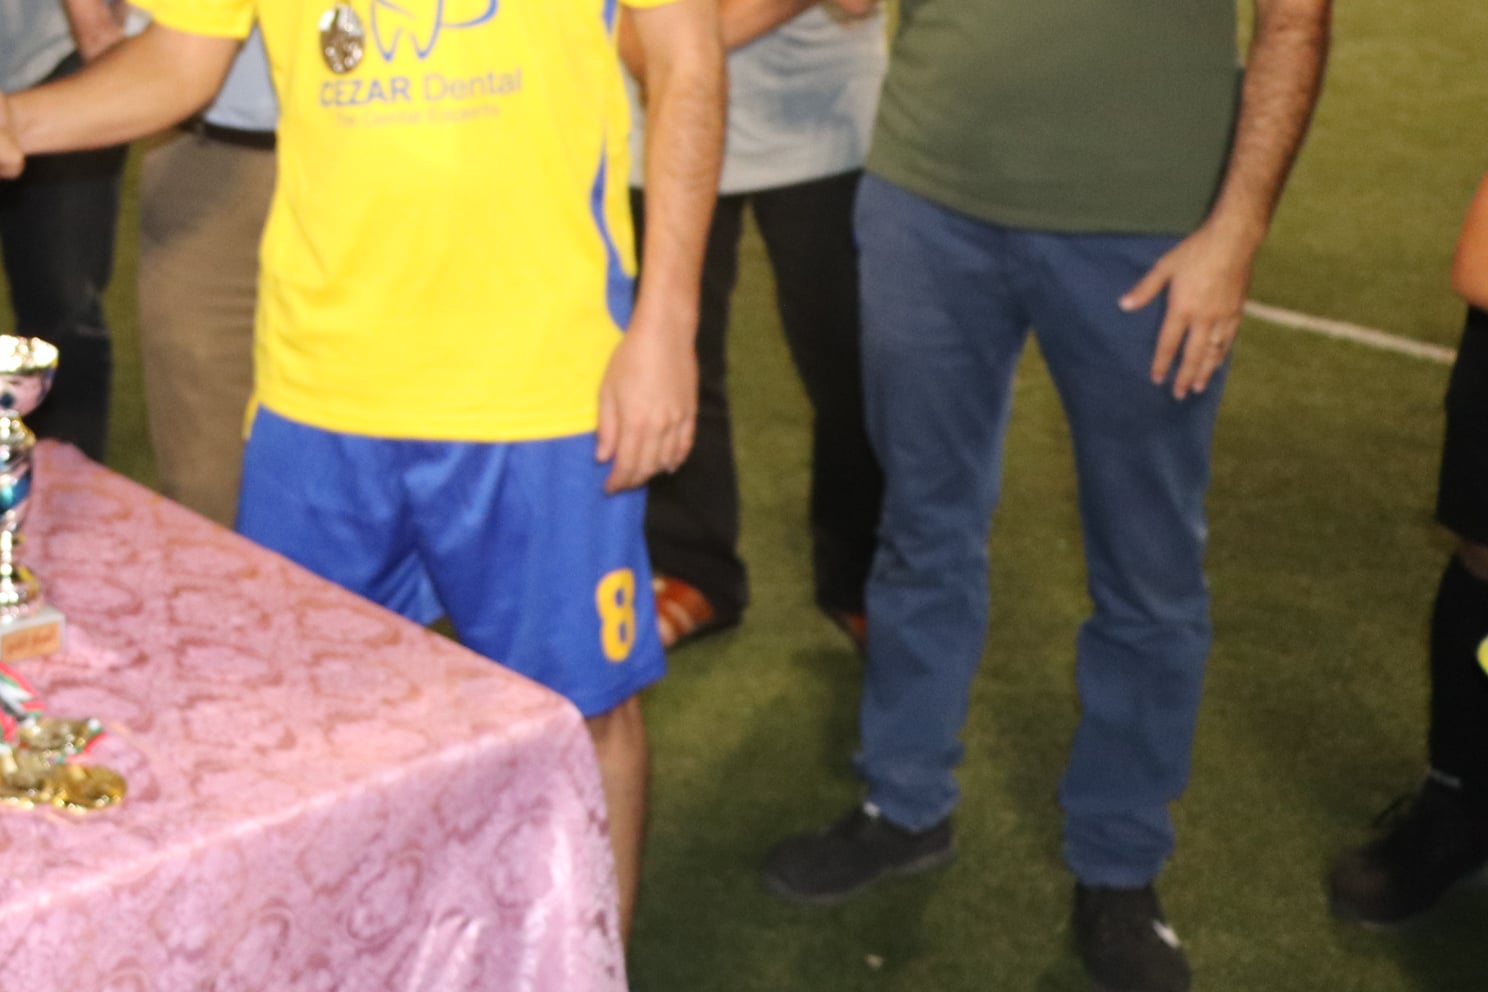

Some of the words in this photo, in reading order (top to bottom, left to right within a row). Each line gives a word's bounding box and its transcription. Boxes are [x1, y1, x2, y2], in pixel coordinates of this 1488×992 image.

[320, 75, 412, 108] CEZAR
[423, 65, 522, 104] Dental
[595, 566, 637, 664] 8
